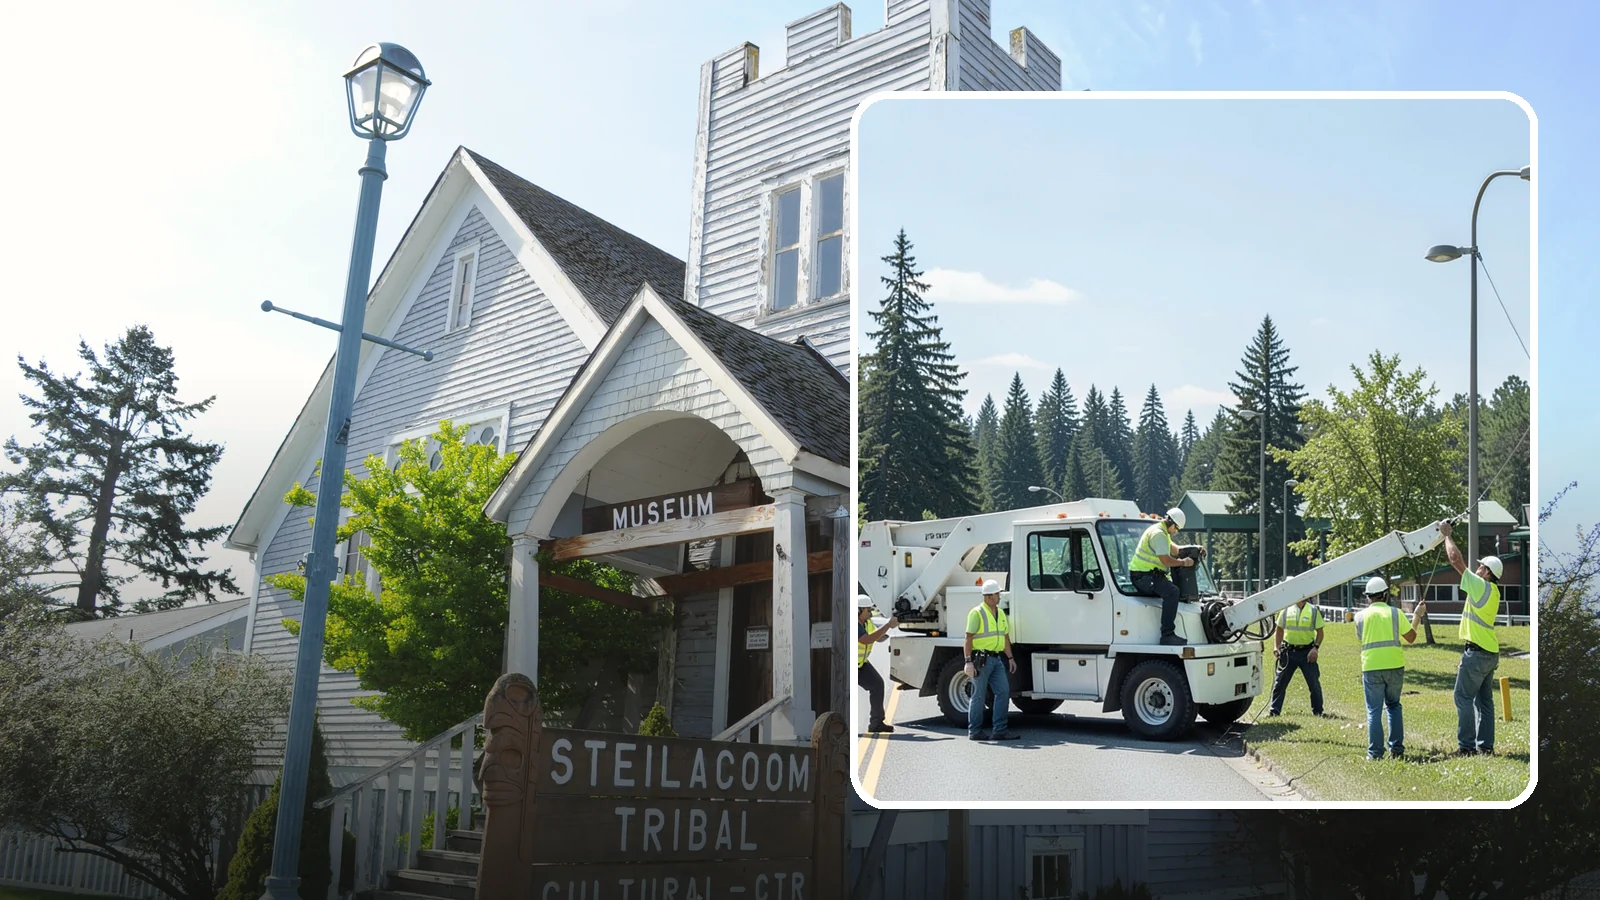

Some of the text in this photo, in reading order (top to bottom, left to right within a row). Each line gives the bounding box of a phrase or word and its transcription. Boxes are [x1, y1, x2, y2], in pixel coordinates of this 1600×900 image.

[613, 491, 713, 530] MUSEUM
[551, 738, 809, 792] STEILACOOM
[614, 806, 757, 852] TRIBAL
